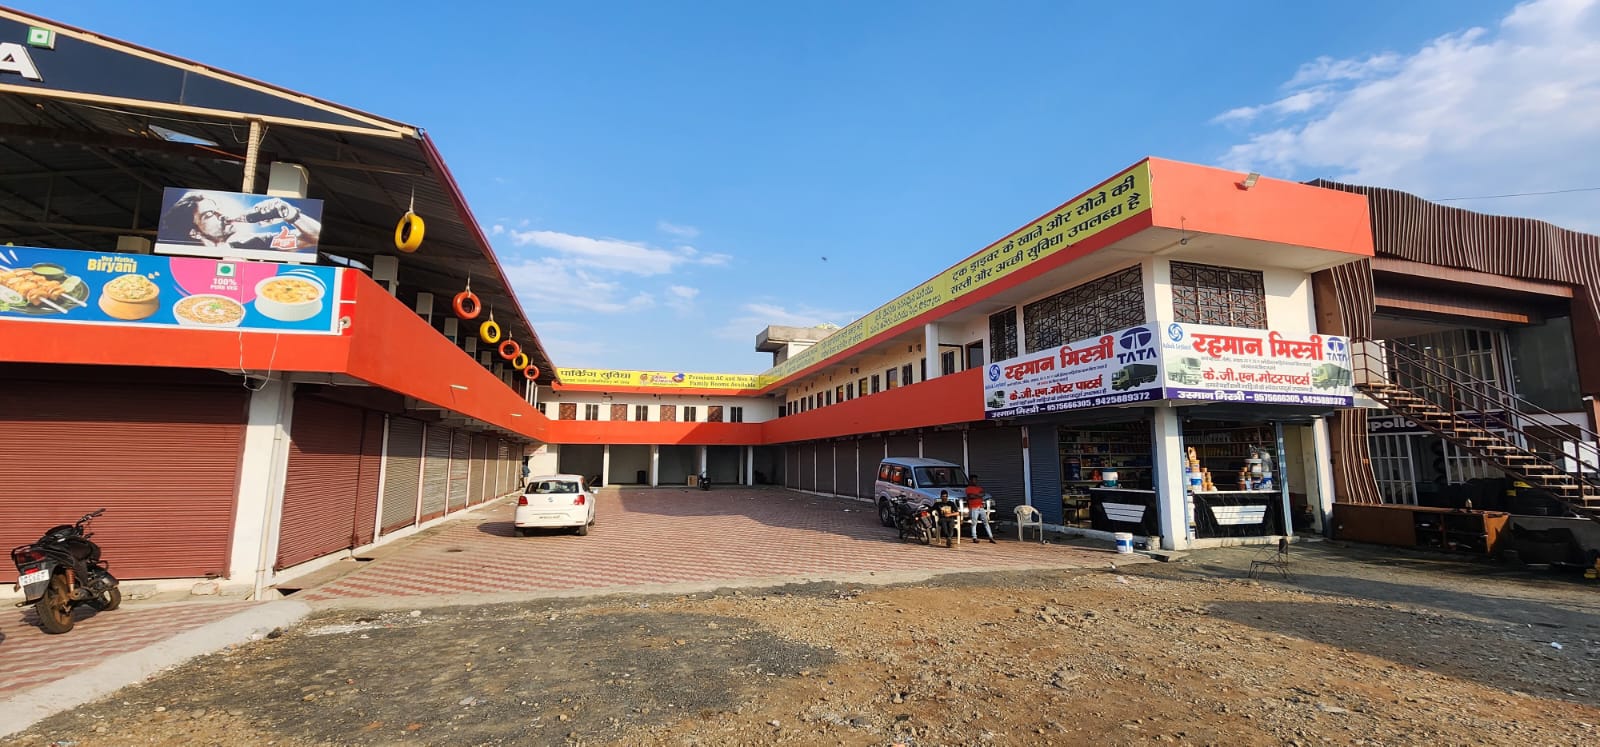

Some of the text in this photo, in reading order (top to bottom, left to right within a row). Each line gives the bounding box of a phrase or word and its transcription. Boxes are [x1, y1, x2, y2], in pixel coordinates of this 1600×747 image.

[970, 249, 999, 271] ड्राइवर
[1002, 241, 1014, 253] के
[1017, 225, 1042, 246] खाने
[1046, 210, 1072, 231] और
[1076, 192, 1106, 216] सोने
[1111, 175, 1135, 197] की
[974, 267, 992, 282] और
[995, 251, 1023, 272] अच्छी
[1027, 233, 1063, 260] सुविधा
[1068, 204, 1122, 237] उपलब्ध
[1128, 193, 1141, 211] है
[87, 258, 137, 273] Biryani
[212, 278, 238, 286] 100%
[1191, 331, 1323, 360] रहमान मिस्त्री
[1004, 355, 1055, 380] रहमान
[1060, 335, 1114, 368] मिस्त्री
[1117, 347, 1157, 364] TATA
[1326, 352, 1348, 361] TATA
[1177, 390, 1214, 401] उस्मान
[1215, 389, 1245, 402] मिस्त्री
[992, 410, 1015, 418] उस्मान
[1016, 405, 1039, 416] मिस्त्री
[1368, 416, 1417, 431] pollo
